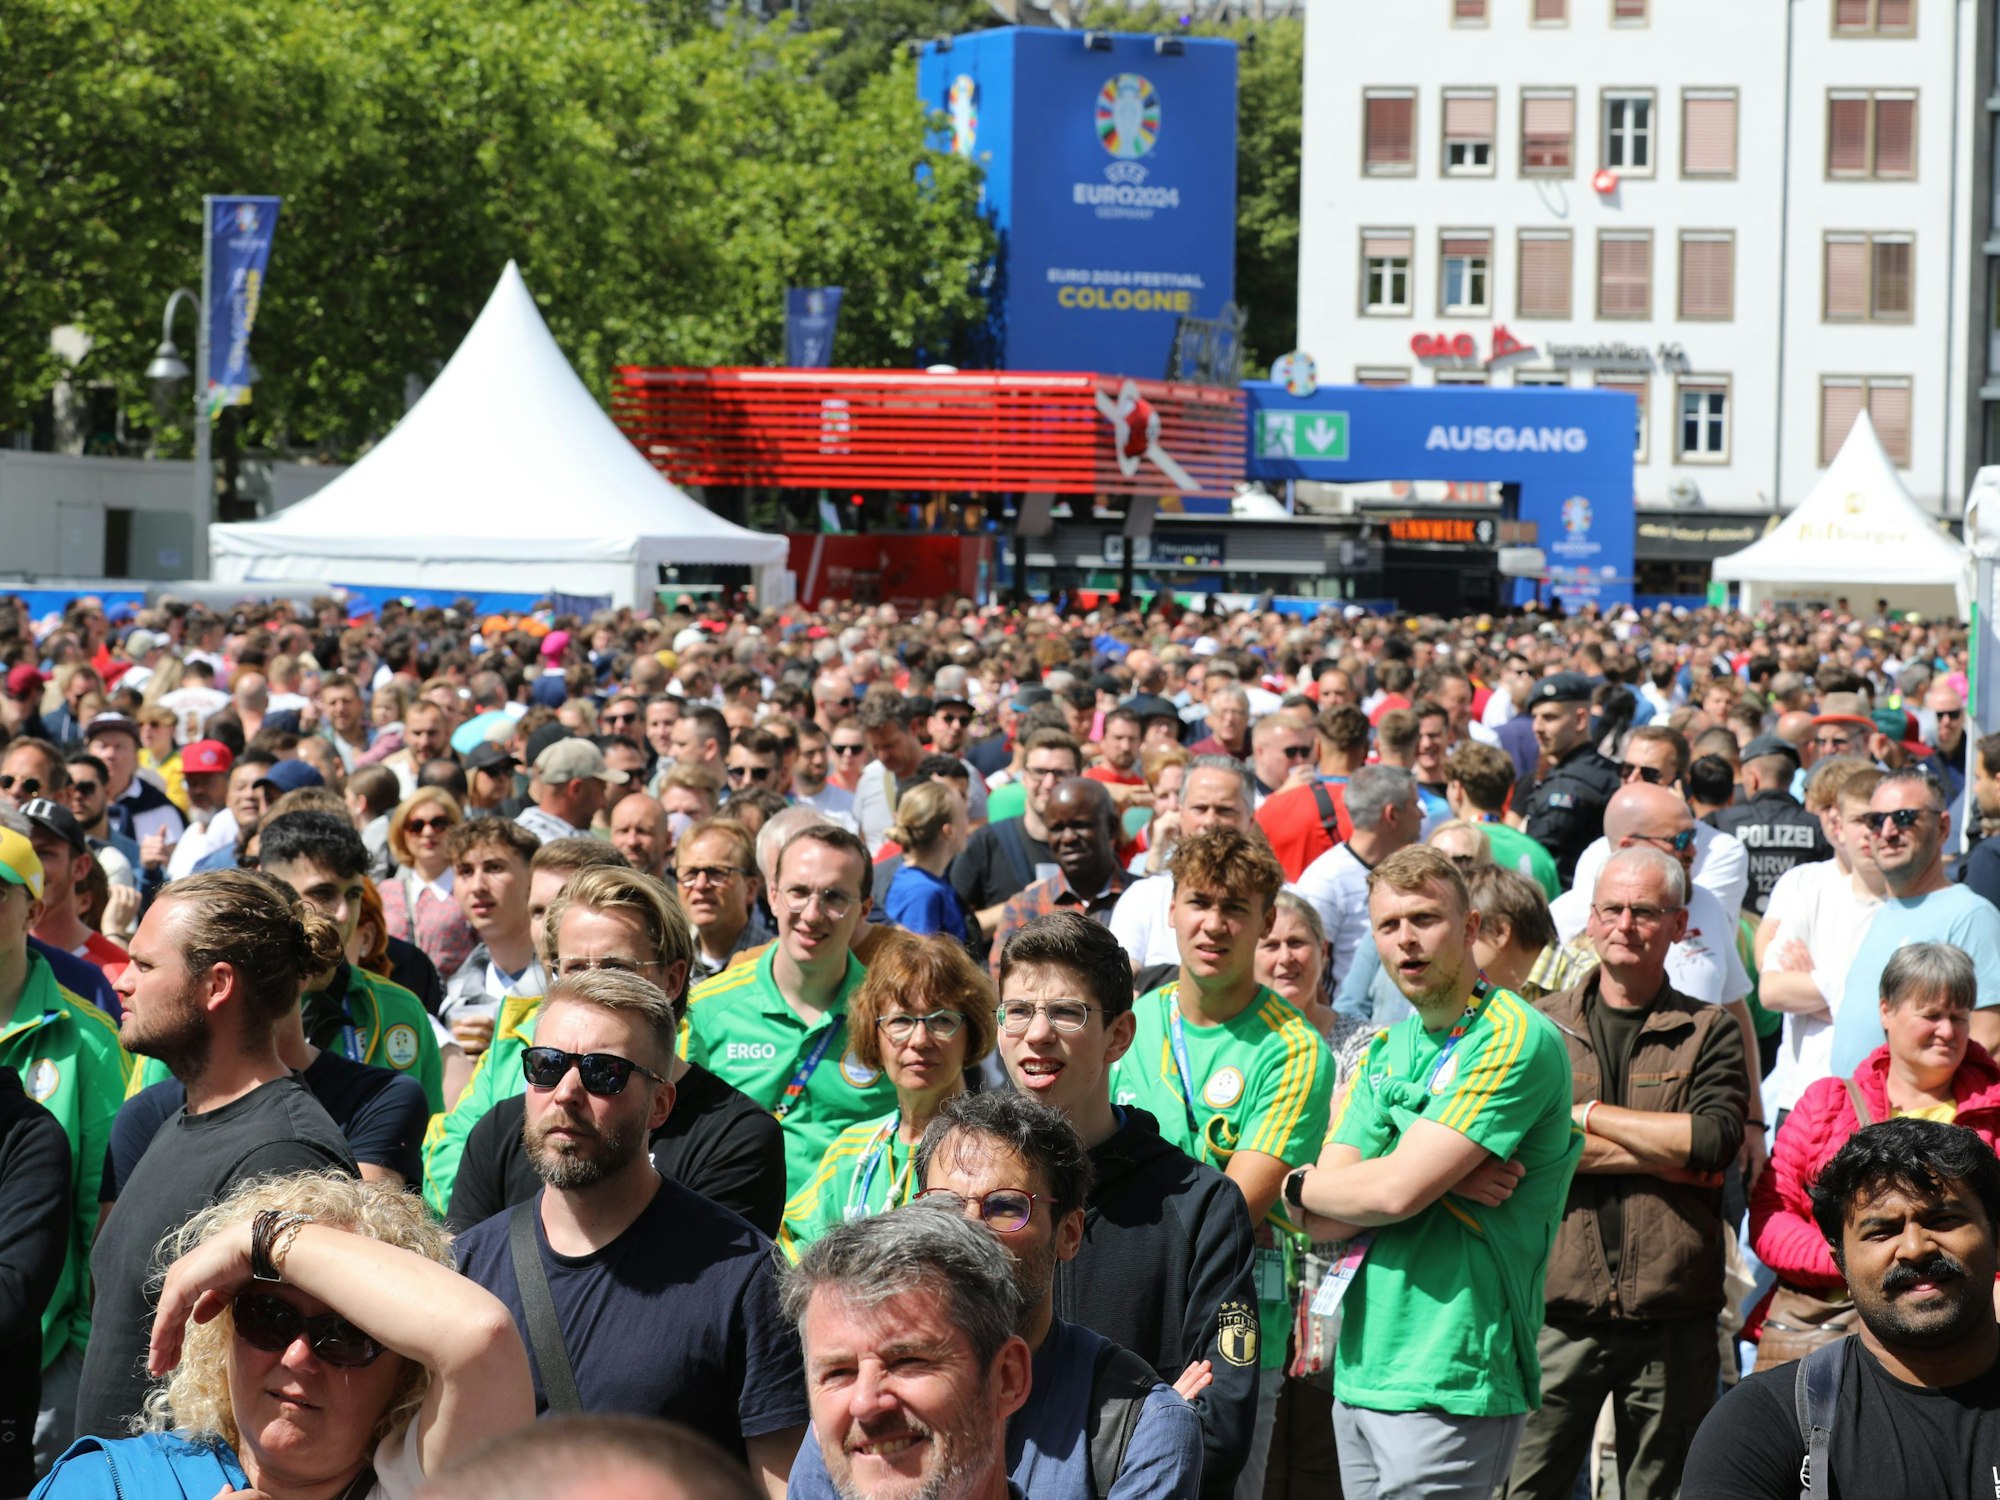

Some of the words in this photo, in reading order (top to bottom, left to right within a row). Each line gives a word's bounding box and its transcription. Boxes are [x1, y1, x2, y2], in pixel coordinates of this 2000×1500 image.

[1072, 183, 1180, 208] EURO2024
[1047, 268, 1090, 283] EURO
[1092, 270, 1131, 285] 2024
[1134, 272, 1205, 288] FESTIVAL
[1058, 286, 1191, 312] COLOGNE
[1410, 333, 1474, 358] GAG
[1425, 425, 1588, 452] AUSGANG
[1736, 824, 1815, 848] POLIZEI
[1750, 856, 1796, 873] NRW
[727, 1043, 776, 1059] ERGO
[1222, 1314, 1256, 1331] ITALIA
